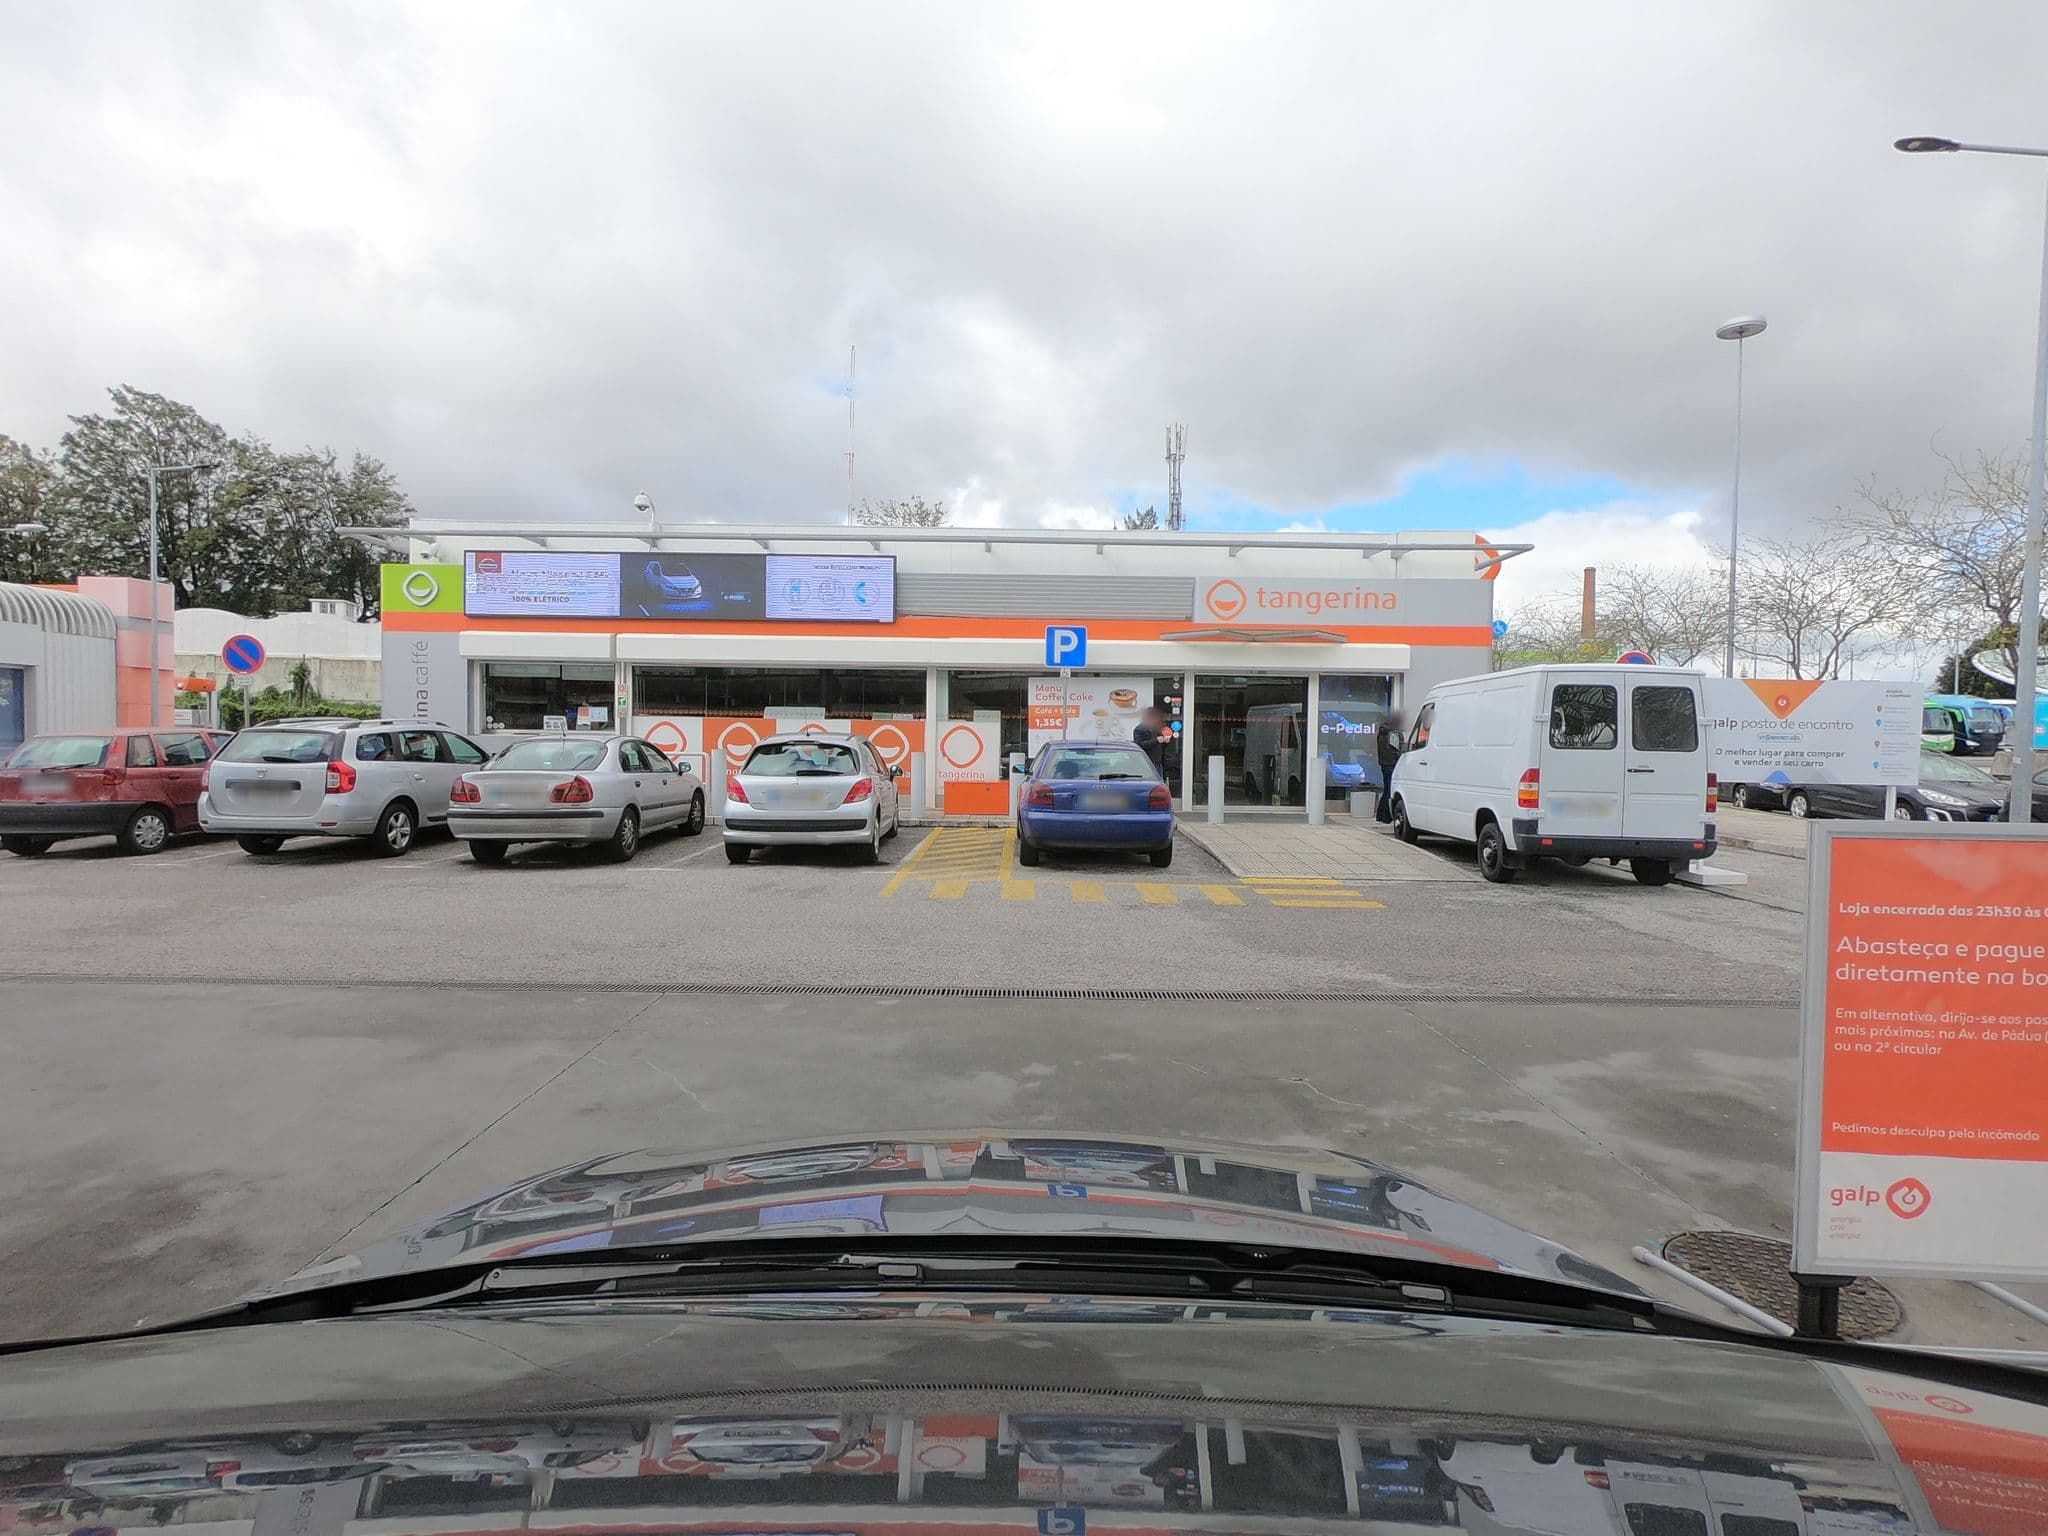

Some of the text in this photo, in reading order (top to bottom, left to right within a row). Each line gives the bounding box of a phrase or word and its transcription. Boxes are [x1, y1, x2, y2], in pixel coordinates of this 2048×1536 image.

[512, 595, 532, 603] 100%
[1256, 586, 1398, 615] tangerina
[1054, 629, 1079, 664] P
[412, 640, 429, 686] caffé
[1035, 684, 1062, 692] Menu
[1069, 693, 1094, 701] Cake
[1034, 718, 1063, 728] 1,35€
[1320, 723, 1376, 734] e-Pedal
[1741, 721, 1777, 731] posto
[1780, 719, 1795, 730] de
[1797, 721, 1854, 730] encontro
[1725, 748, 1757, 756] melhor
[1758, 749, 1783, 759] lugar
[1784, 751, 1805, 760] para
[1806, 751, 1845, 760] comprar
[938, 770, 985, 780] tangerina
[1839, 903, 1870, 916] Loja
[1873, 905, 1945, 916] encerrada
[1948, 906, 1973, 916] das
[1976, 906, 2022, 917] 23h30
[2025, 906, 2041, 918] às
[1836, 936, 2045, 963] Abasteça e pague
[1836, 963, 1980, 984] diretamente
[1987, 972, 2014, 985] na
[1835, 1008, 1857, 1018] Em
[1860, 1009, 1937, 1023] alternativa,
[1940, 1011, 1995, 1026] dirija-se
[1999, 1014, 2022, 1025] aos
[1835, 1025, 1866, 1035] mais
[1870, 1026, 1935, 1039] próximos:
[1939, 1030, 1955, 1039] na
[1958, 1029, 1977, 1040] Av.
[1981, 1030, 1998, 1040] de
[2001, 1030, 2042, 1042] Pádua
[1834, 1042, 1851, 1051] ou
[1855, 1043, 1872, 1052] na
[1893, 1043, 1942, 1055] circular
[1832, 1122, 1887, 1135] Pedimos
[1889, 1125, 1946, 1139] desculpa
[1949, 1128, 1975, 1140] pelo
[1830, 1185, 1880, 1206] galp
